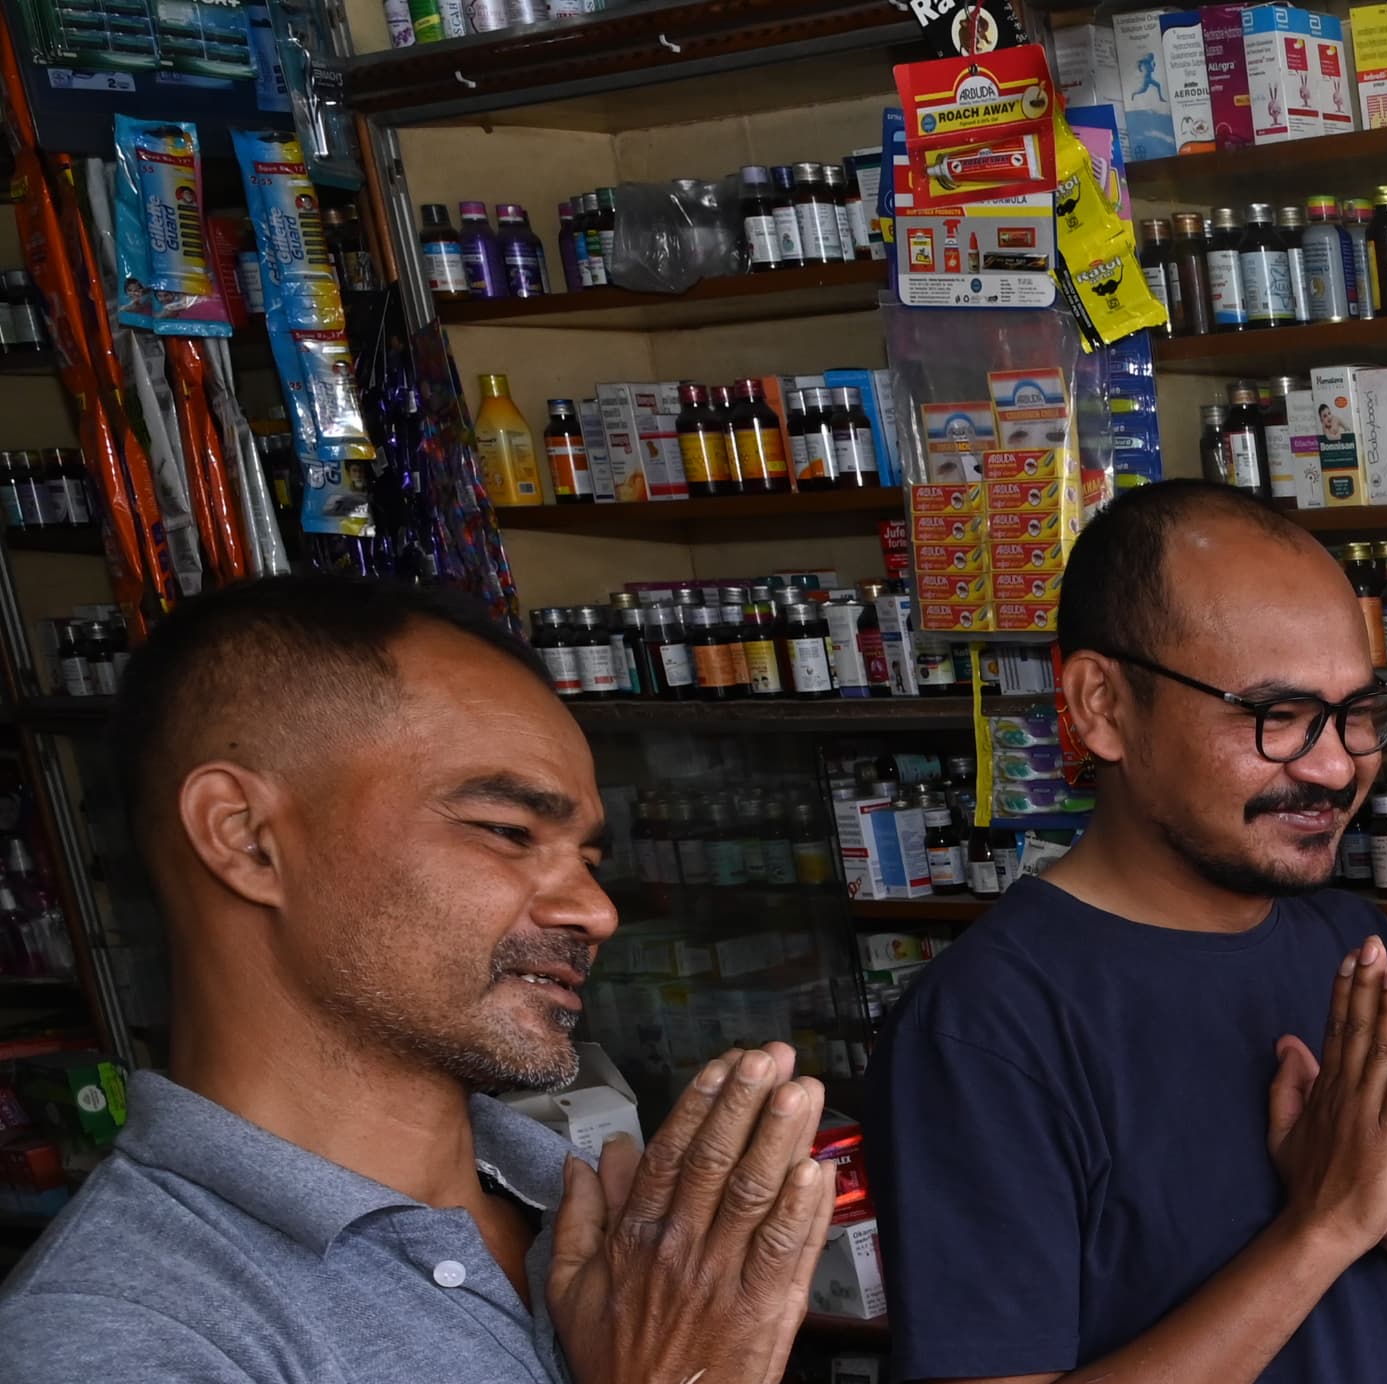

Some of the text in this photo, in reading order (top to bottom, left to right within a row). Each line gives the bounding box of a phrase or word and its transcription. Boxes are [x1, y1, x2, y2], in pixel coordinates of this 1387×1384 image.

[959, 83, 997, 101] ARBUDA
[938, 104, 1016, 123] ROACH AWAY
